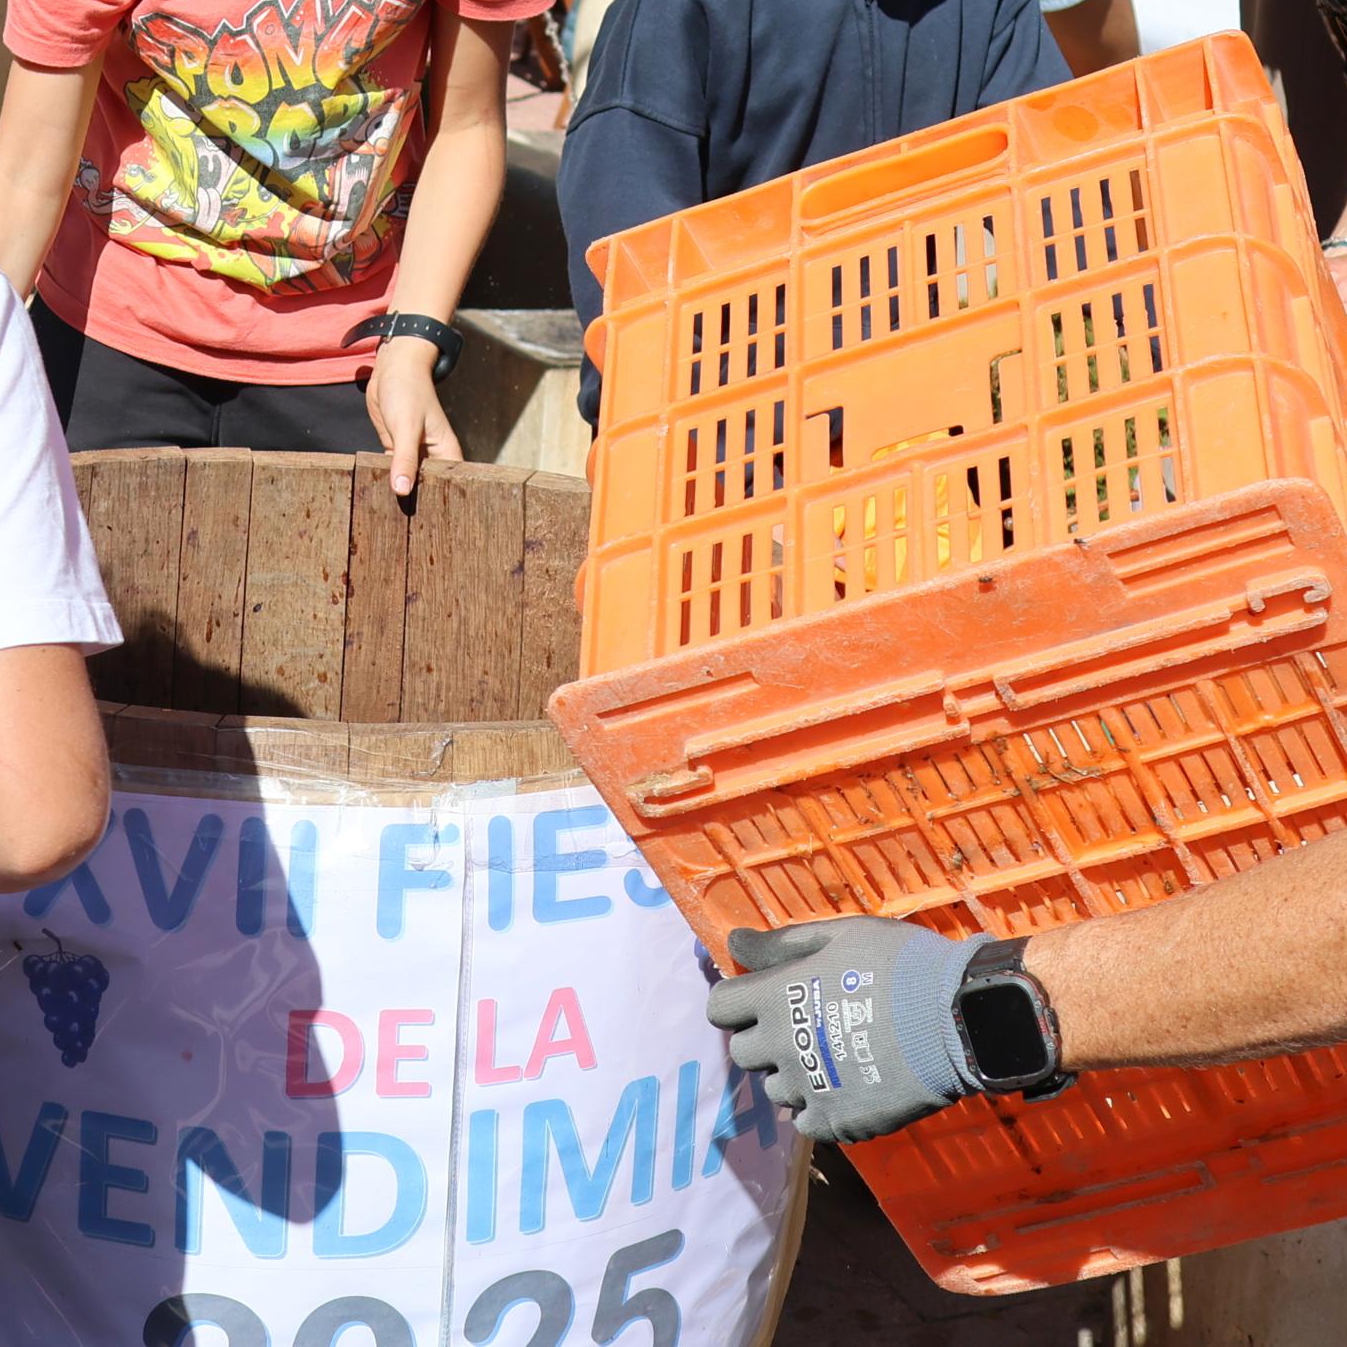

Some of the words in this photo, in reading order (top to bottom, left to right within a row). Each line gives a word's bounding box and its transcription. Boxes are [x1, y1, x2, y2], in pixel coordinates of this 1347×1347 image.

[861, 972, 874, 986] M
[285, 1007, 436, 1100] DE
[475, 985, 598, 1087] LA
[787, 982, 830, 1093] ECOPU
[826, 1001, 847, 1062] 141210
